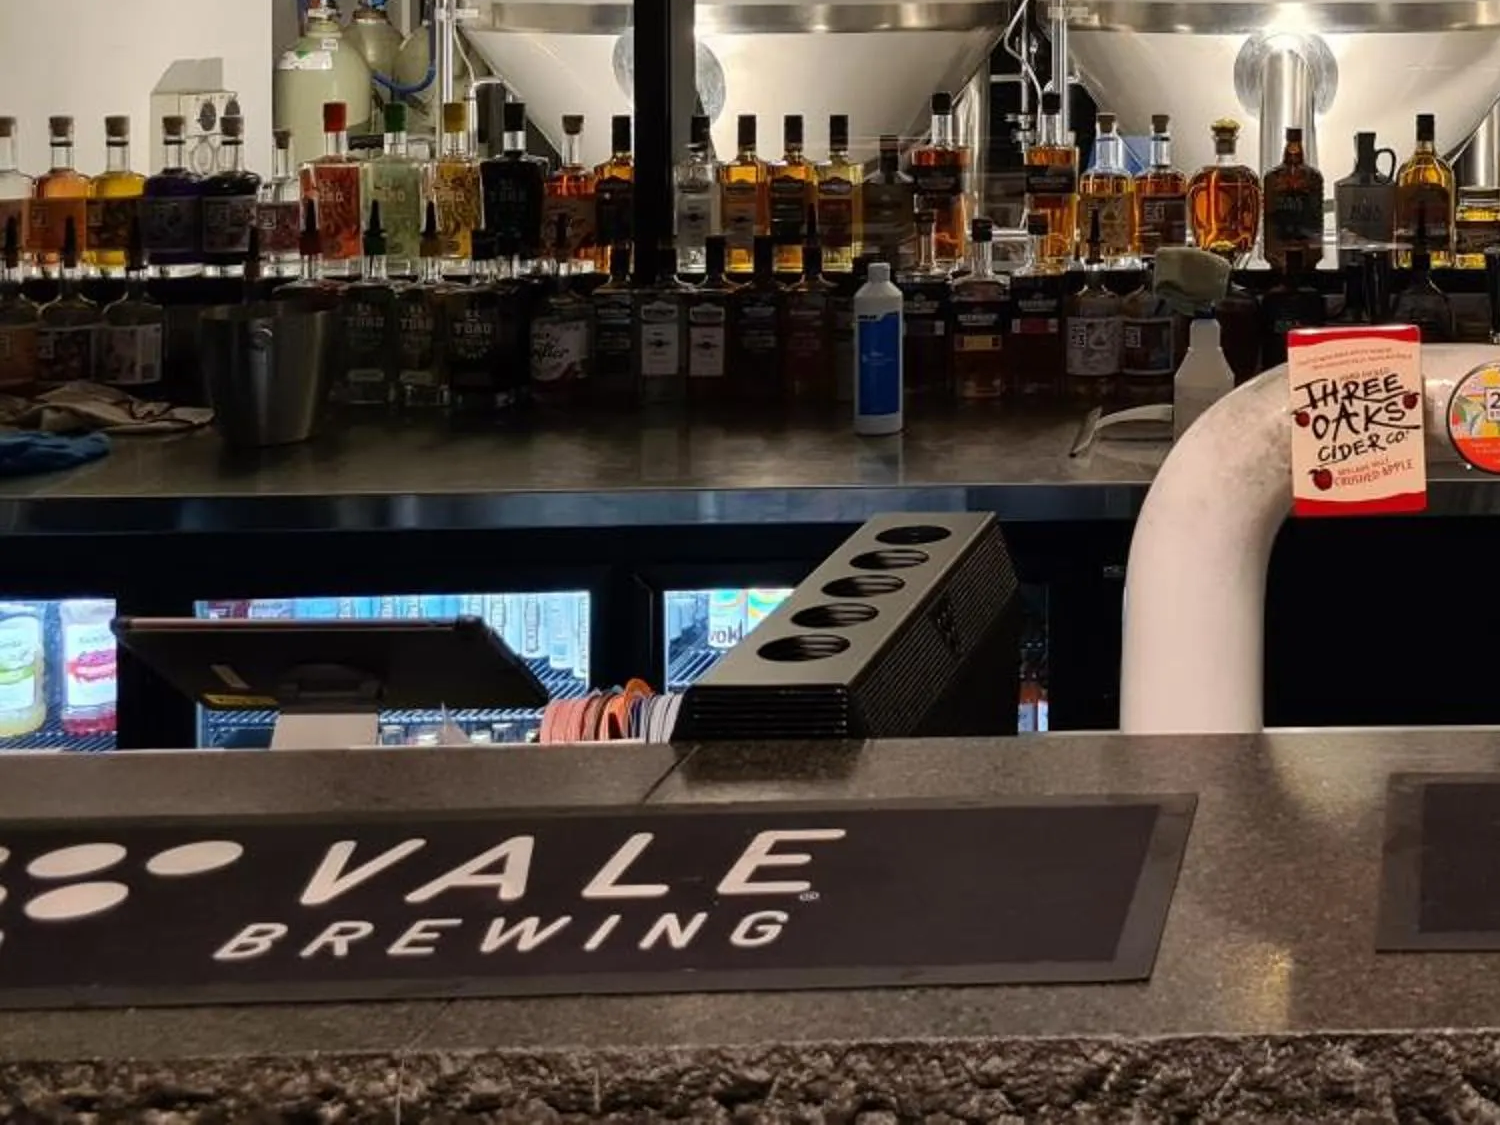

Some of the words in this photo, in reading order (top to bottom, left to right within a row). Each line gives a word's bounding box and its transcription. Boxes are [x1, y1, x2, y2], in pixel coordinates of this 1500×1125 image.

[1294, 373, 1404, 409] THREE
[1312, 399, 1420, 442] OAKS
[1318, 432, 1387, 462] CIDER
[299, 829, 846, 906] VALE
[212, 911, 788, 961] BREWING
